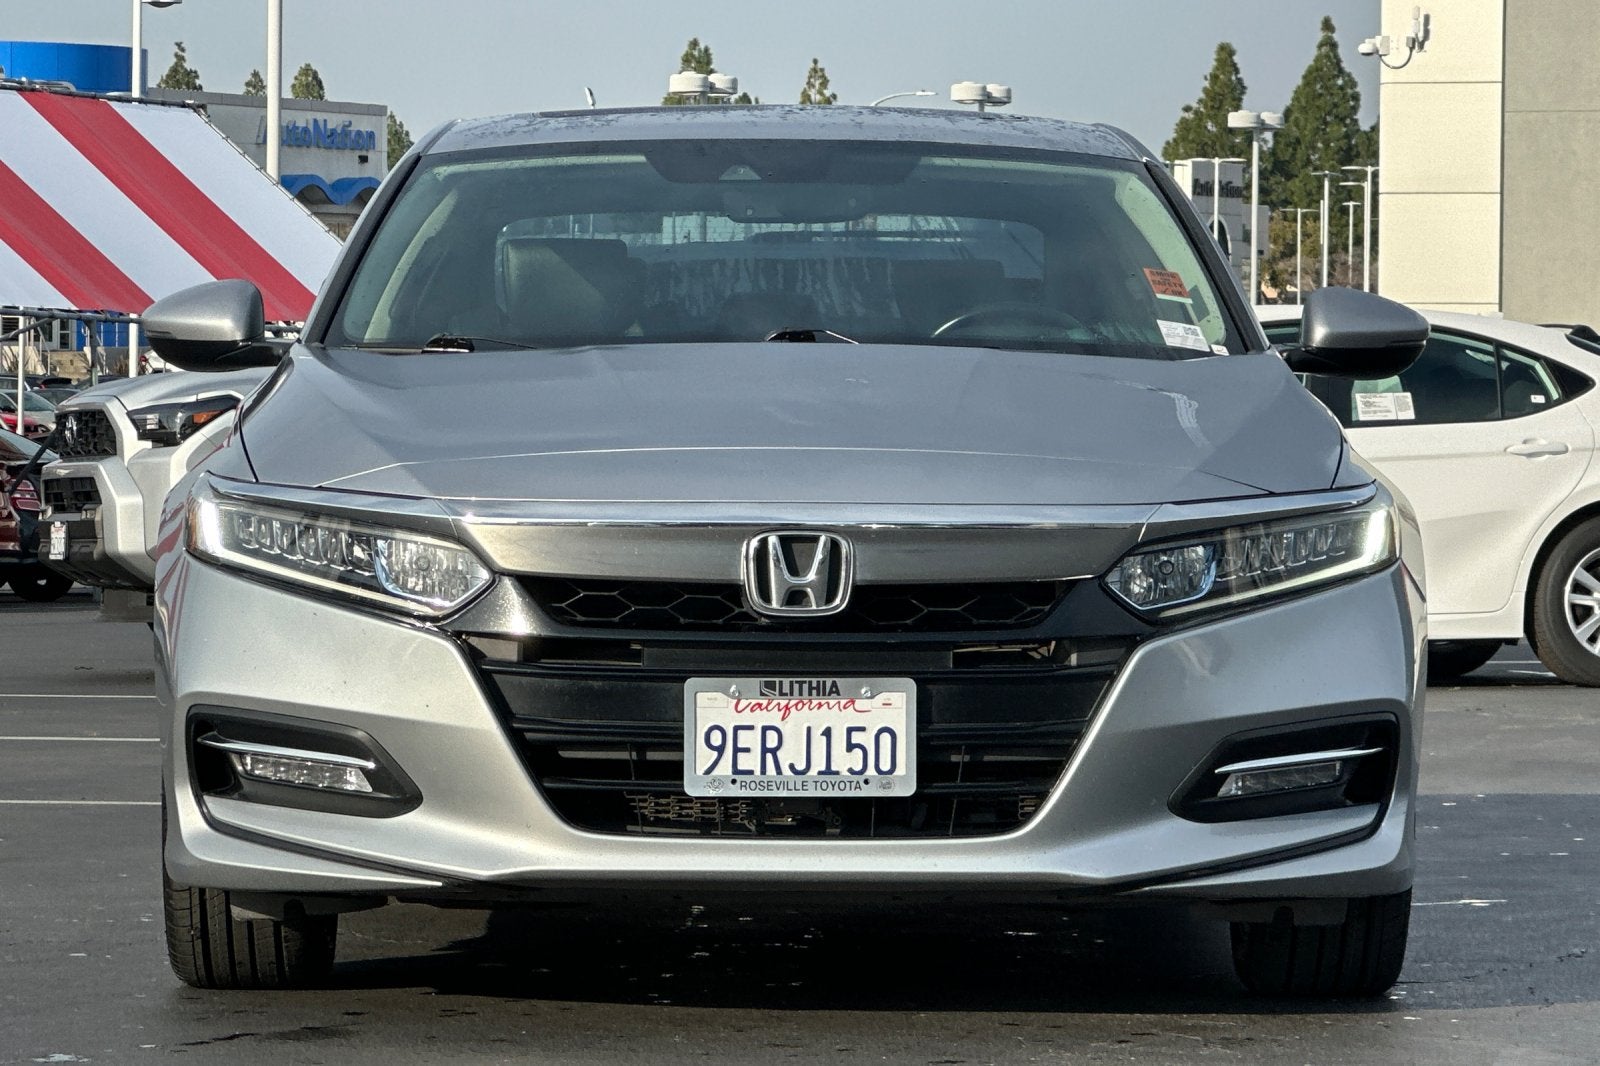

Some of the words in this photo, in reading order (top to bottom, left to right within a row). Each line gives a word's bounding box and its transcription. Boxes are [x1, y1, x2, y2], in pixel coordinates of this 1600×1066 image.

[778, 680, 841, 697] LITHIA
[734, 698, 872, 721] California
[703, 724, 897, 775] 9ERJ150
[740, 780, 809, 791] ROSEVILLE
[813, 780, 862, 791] TOYOTA
